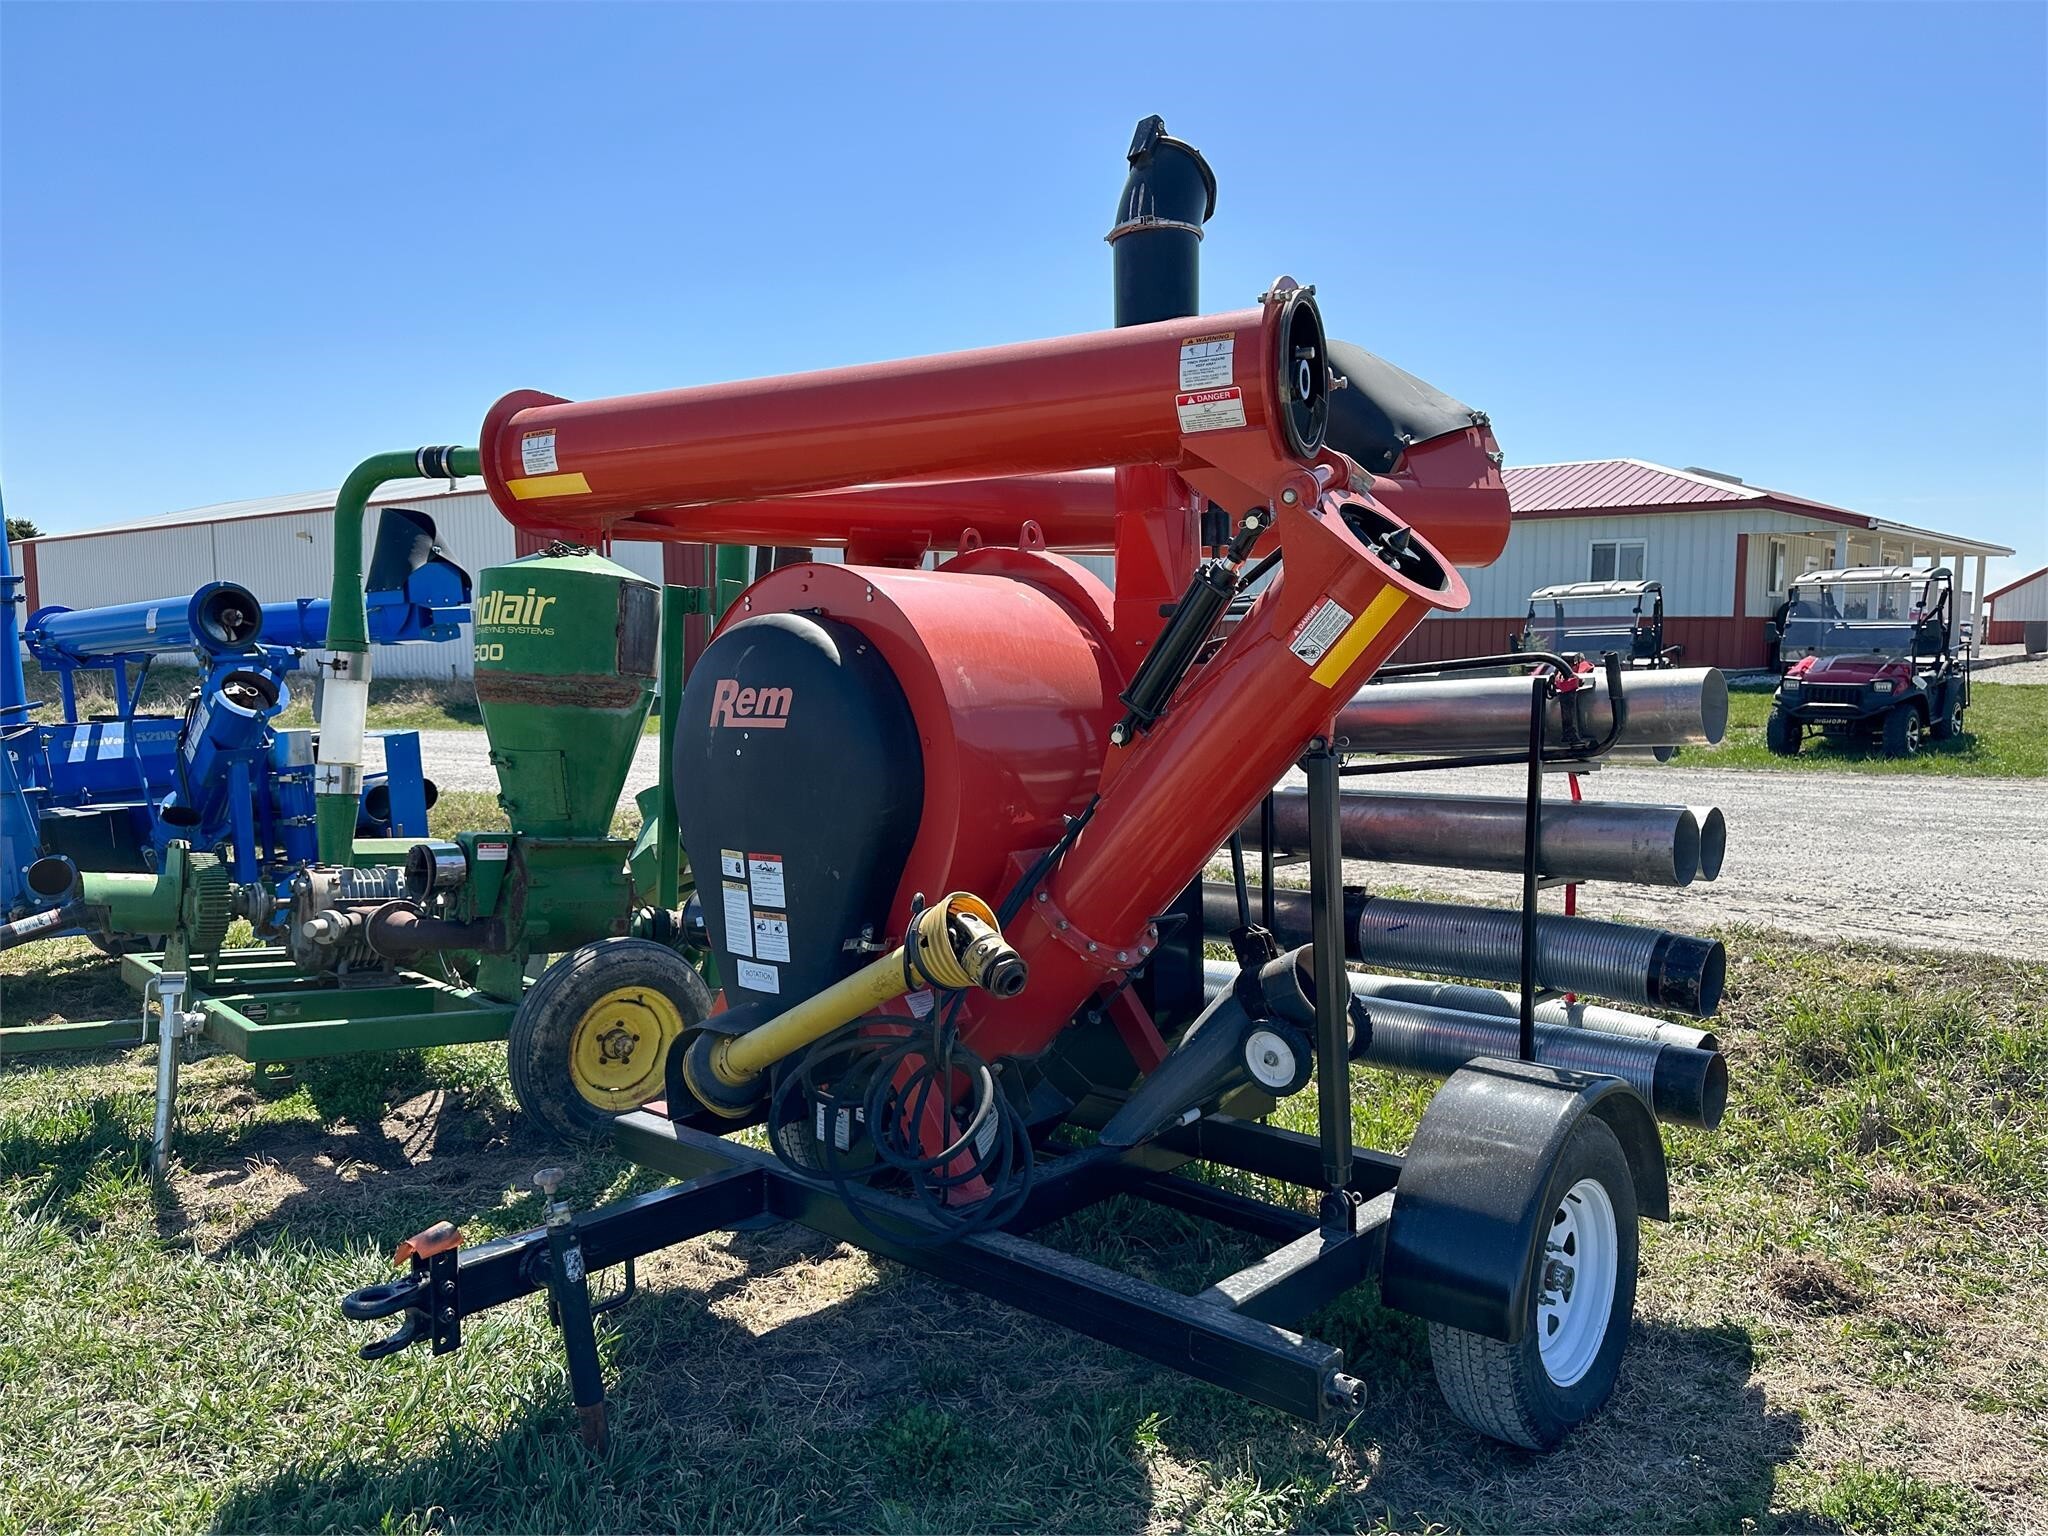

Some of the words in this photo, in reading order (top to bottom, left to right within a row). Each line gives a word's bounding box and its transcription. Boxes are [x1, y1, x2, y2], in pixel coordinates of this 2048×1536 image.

[1196, 334, 1230, 343] WARNING
[1196, 391, 1231, 403] DANGER
[1297, 604, 1320, 631] DANGER
[507, 626, 555, 636] SYSTEMS
[709, 678, 793, 729] Rem
[745, 969, 773, 982] ROTATION
